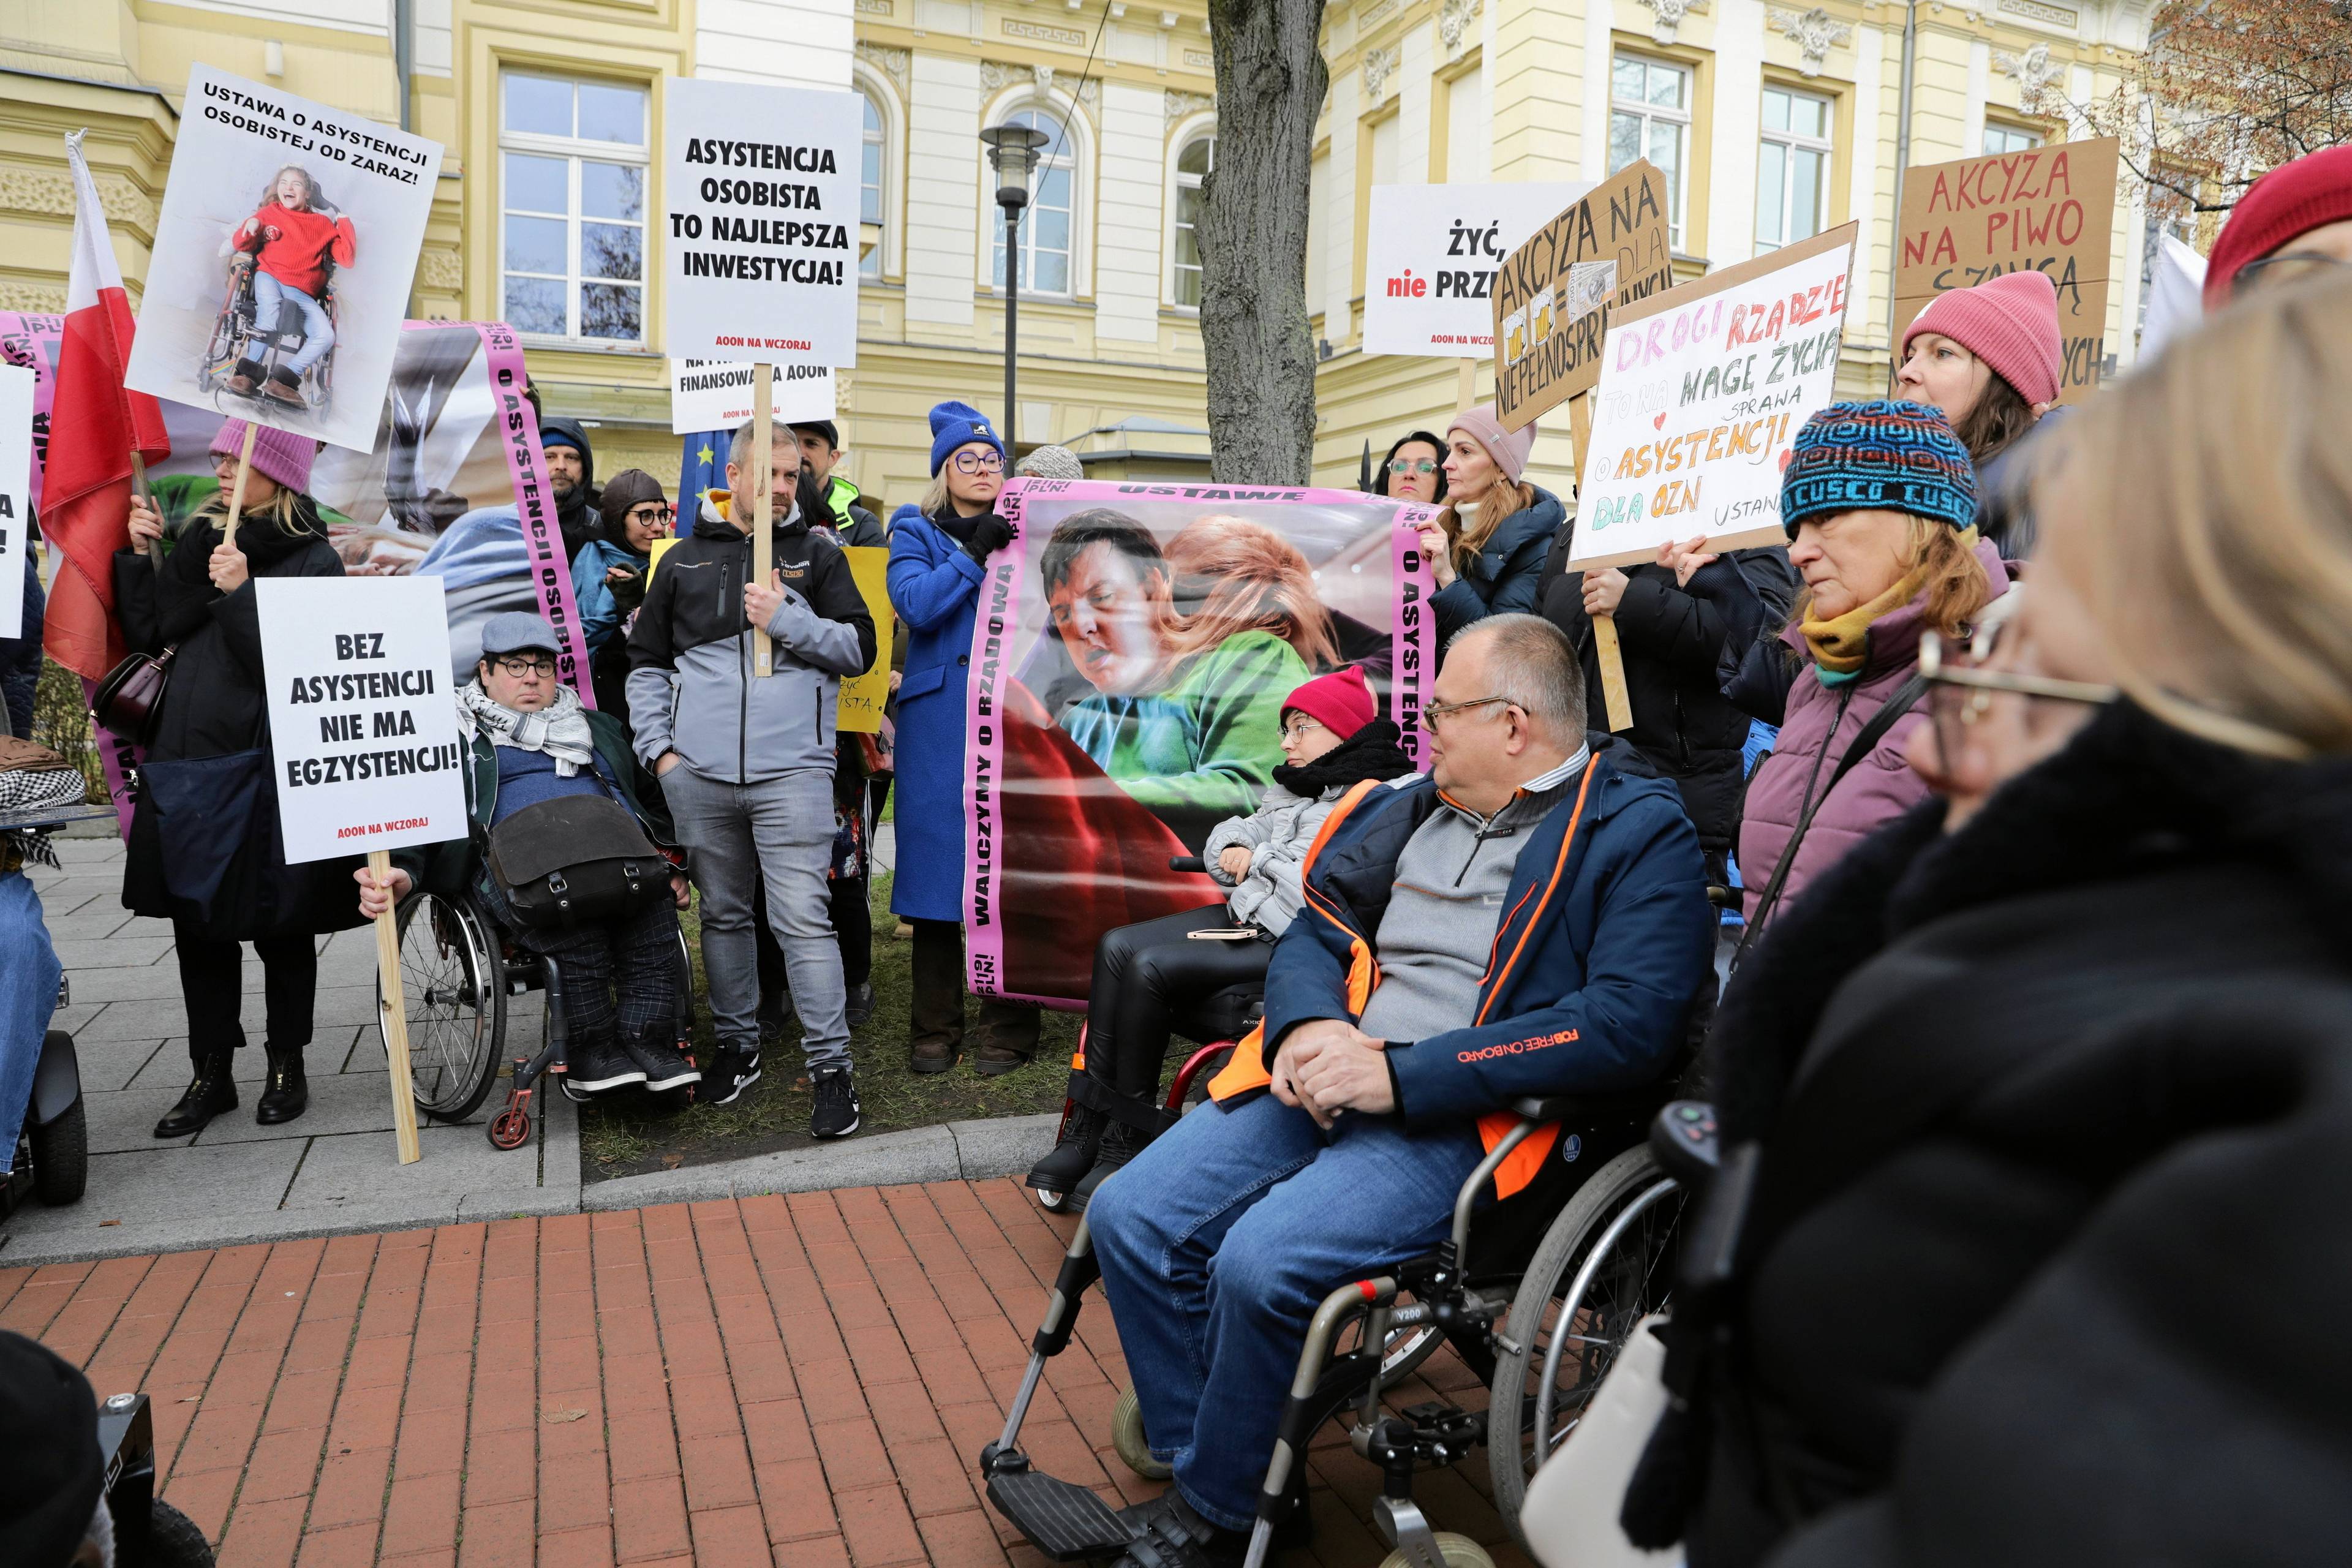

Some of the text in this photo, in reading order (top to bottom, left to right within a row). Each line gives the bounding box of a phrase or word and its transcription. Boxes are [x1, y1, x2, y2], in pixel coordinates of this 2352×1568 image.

[205, 82, 427, 166] USTAWA O ASYSTENCJI
[205, 106, 418, 184] OSOBISTEJ OD ZARAZ!
[685, 138, 836, 174] ASYSTENCJA
[701, 178, 821, 210] OSOBISTA
[1928, 151, 2070, 213] AKCYZA
[670, 213, 848, 249] TO NAJLEPSZA
[1447, 218, 1507, 262] ŻYĆ,
[1499, 173, 1659, 323] AKCYZA NA
[1903, 199, 2084, 268] NA PIWO
[684, 252, 843, 285] INWESTYCJA!
[1618, 227, 1664, 285] DLA
[1387, 268, 1427, 298] nie
[715, 336, 811, 350] AOON NA WCZORAJ
[1431, 334, 1453, 344] AOON
[1456, 335, 1468, 344] NA
[1616, 300, 1725, 372] DROGI
[1765, 326, 1839, 385] ŻYCIA
[498, 369, 512, 387] O
[680, 365, 827, 392] FINANSOWAA AOON
[722, 410, 740, 420] AOON
[741, 409, 750, 417] NA
[1721, 385, 1801, 421] SPRAWA
[1613, 412, 1790, 480] ASYSTENCJI
[502, 394, 553, 560] ASYSTENCJI
[1117, 484, 1307, 502] USTAWĘ
[1795, 480, 1885, 507] CUSCO
[1592, 476, 1703, 531] DLA OZN
[785, 560, 810, 569] avalon
[1403, 550, 1419, 572] O
[335, 633, 385, 660] BEZ
[290, 670, 434, 704] ASYSTENCJI
[320, 710, 417, 742] NIE MA
[974, 564, 1015, 927] WALCZYMY O RZĄDOWĄ
[287, 743, 458, 788] EGZYSTENCJI!
[337, 816, 428, 839] AOON NA WCZORAJ
[1457, 1028, 1579, 1063] FOB FREE ON BOARD
[1396, 1308, 1421, 1321] V200
